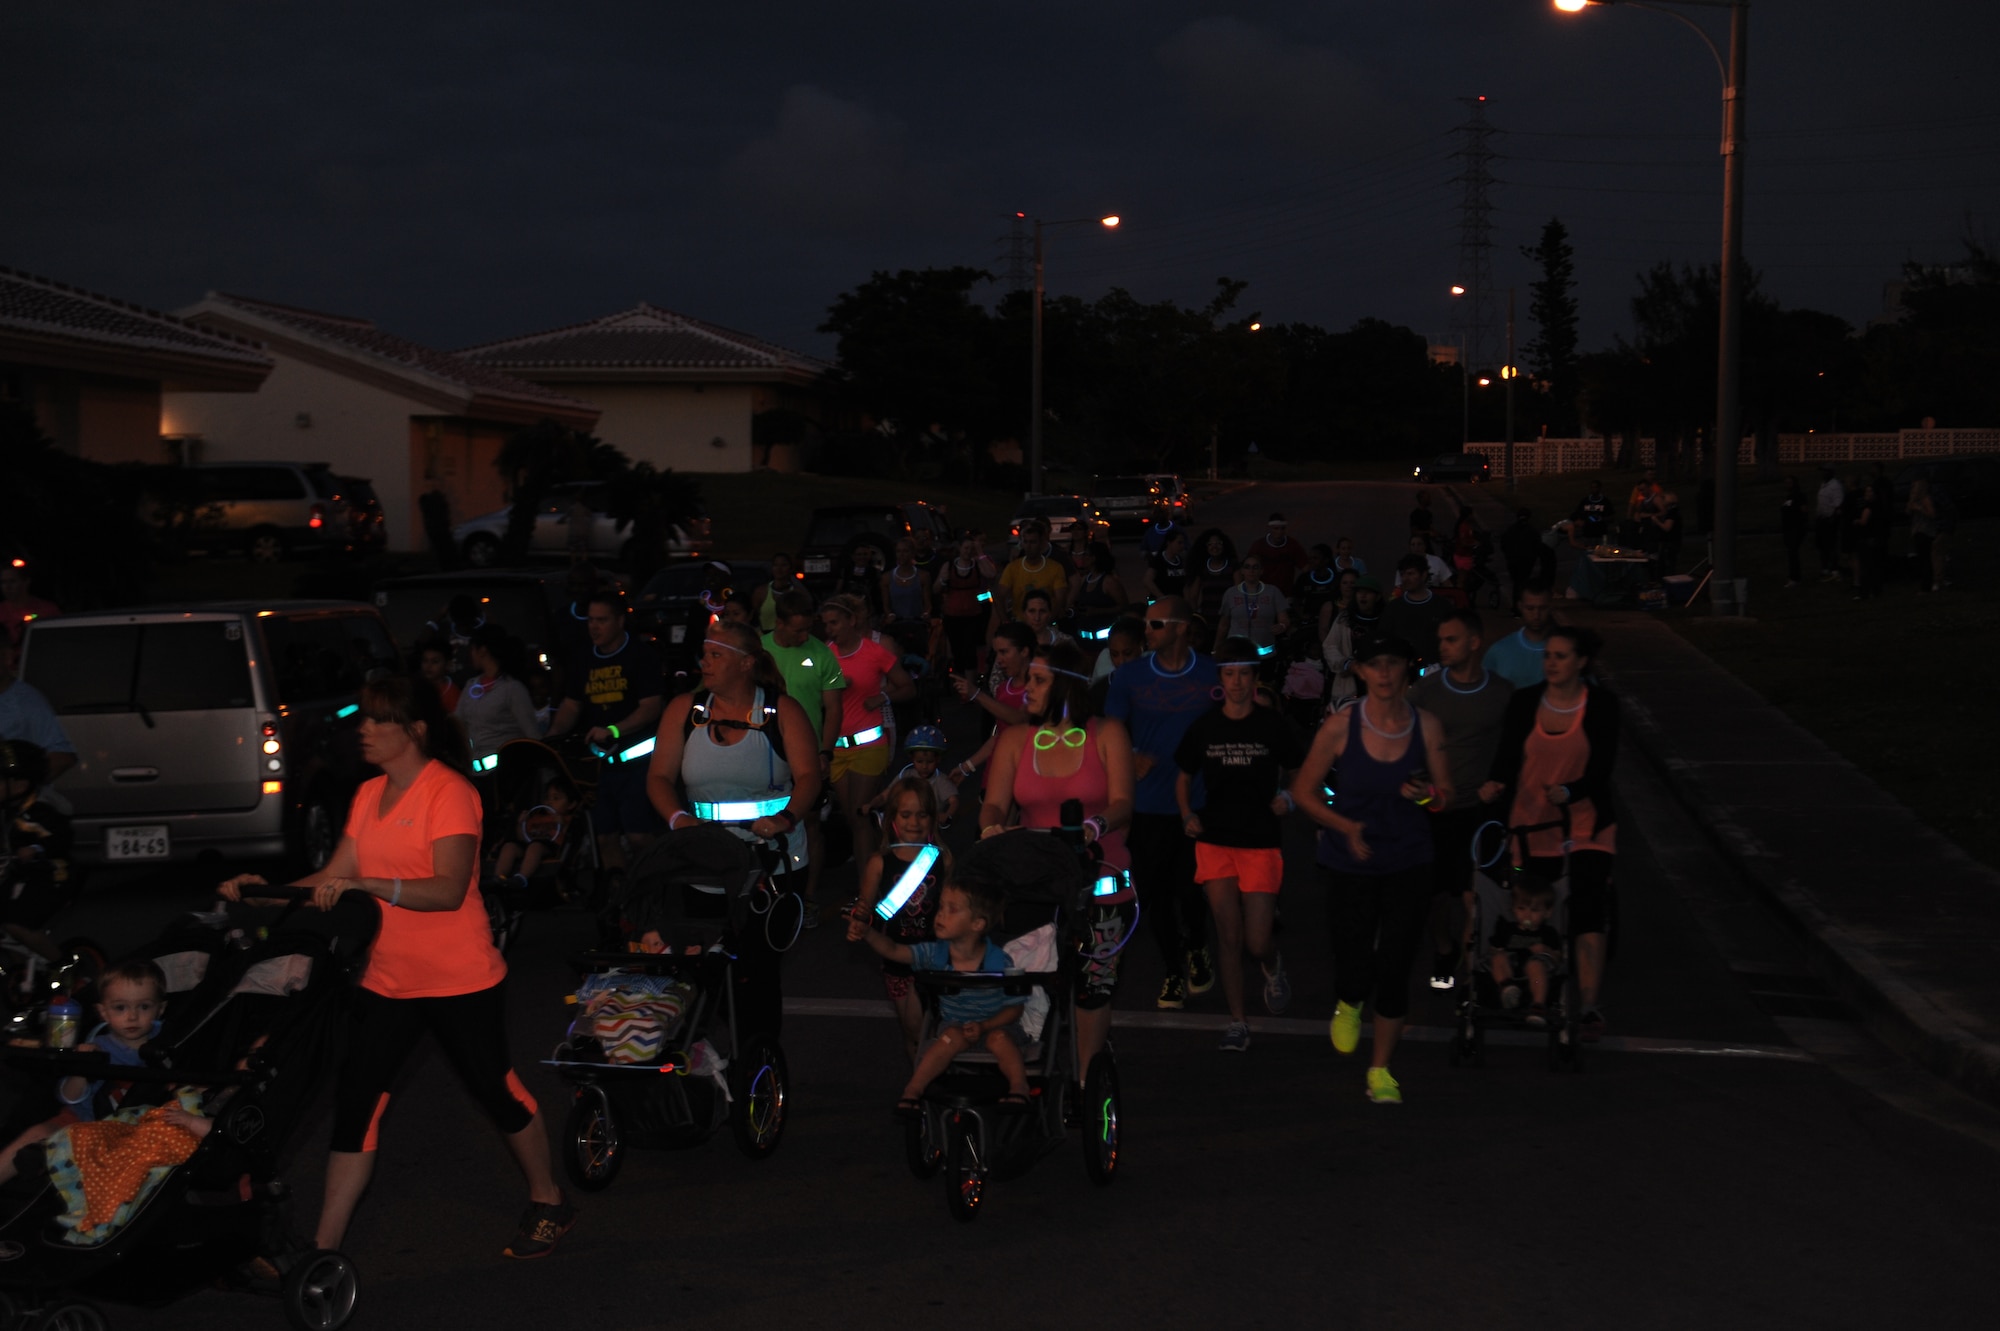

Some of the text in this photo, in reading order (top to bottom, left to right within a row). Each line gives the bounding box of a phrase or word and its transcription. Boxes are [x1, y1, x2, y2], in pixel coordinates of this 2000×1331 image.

[589, 665, 622, 681] UNDER
[585, 677, 628, 695] ARMOUR
[1222, 756, 1252, 766] FAMILY
[122, 838, 165, 855] 84-69
